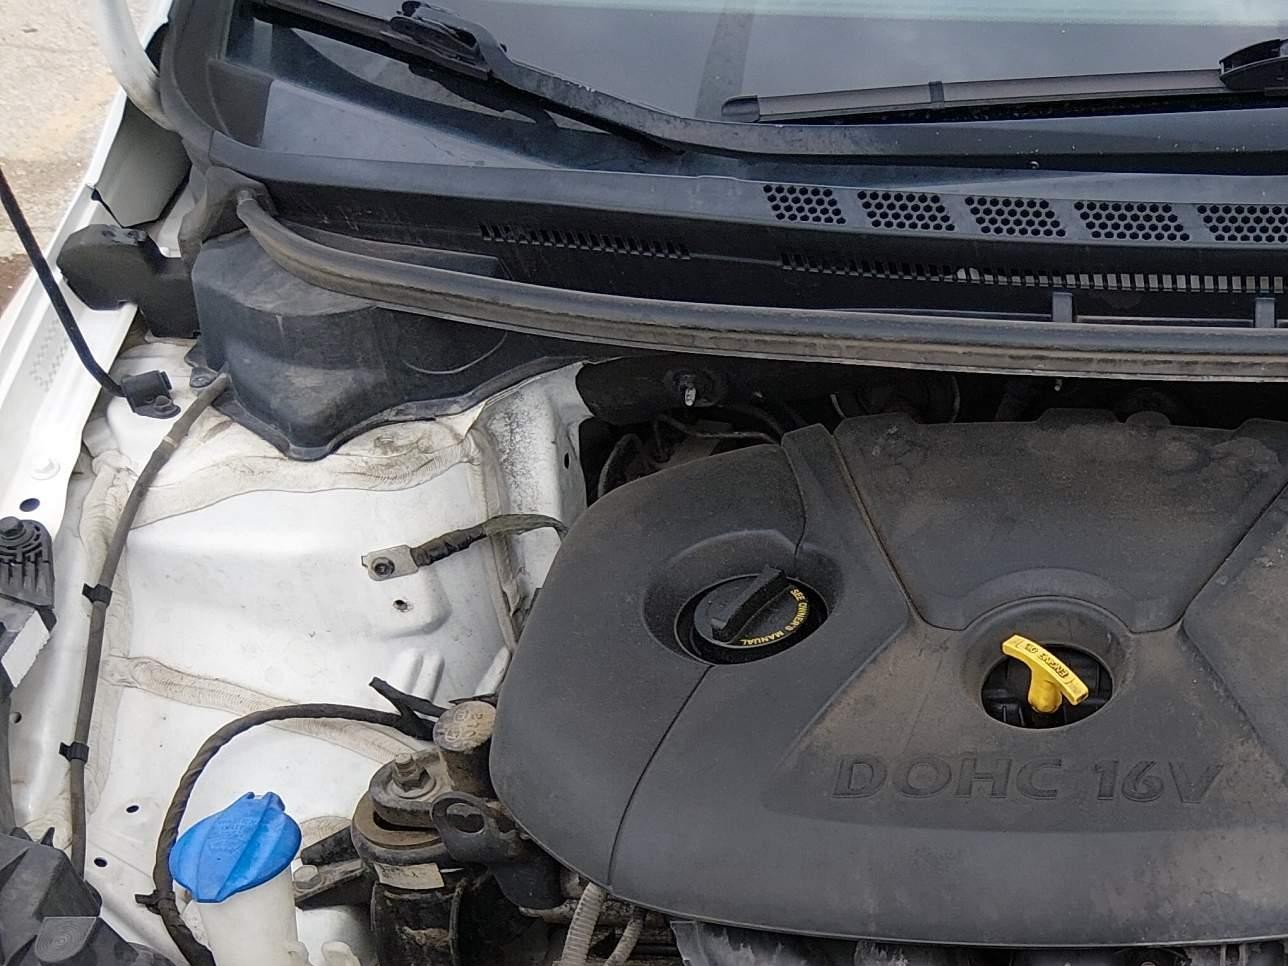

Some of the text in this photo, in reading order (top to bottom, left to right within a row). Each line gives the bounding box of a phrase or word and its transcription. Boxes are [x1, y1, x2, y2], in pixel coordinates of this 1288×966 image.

[790, 588, 806, 604] SEE
[740, 630, 785, 646] MANUAL
[832, 754, 1226, 804] DOHC 16V
